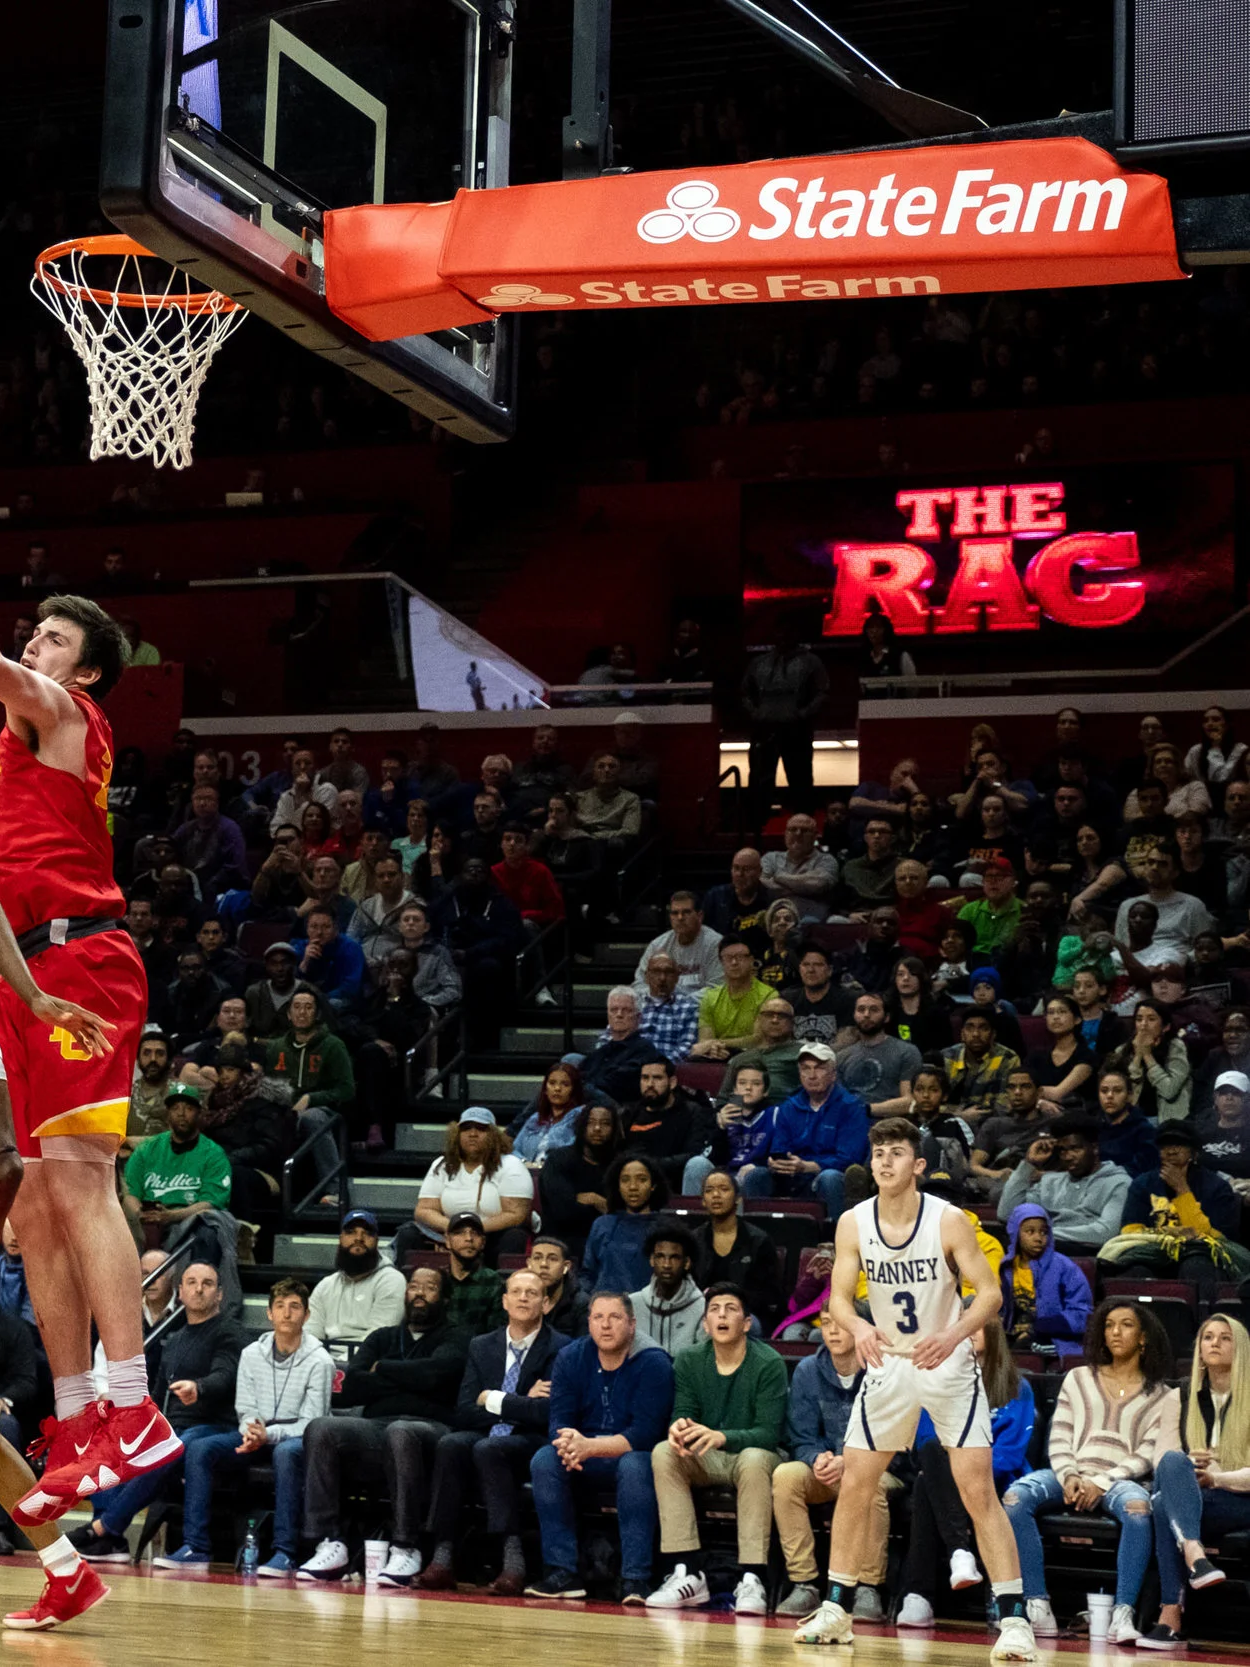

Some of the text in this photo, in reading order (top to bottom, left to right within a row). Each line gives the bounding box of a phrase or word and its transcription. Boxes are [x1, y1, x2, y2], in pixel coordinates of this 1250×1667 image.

[580, 274, 941, 304] State Farm
[895, 482, 1066, 540] THE
[822, 532, 1146, 637] RAC
[144, 1172, 202, 1189] Phillies
[865, 1257, 938, 1285] RANNEY
[892, 1291, 919, 1334] 3
